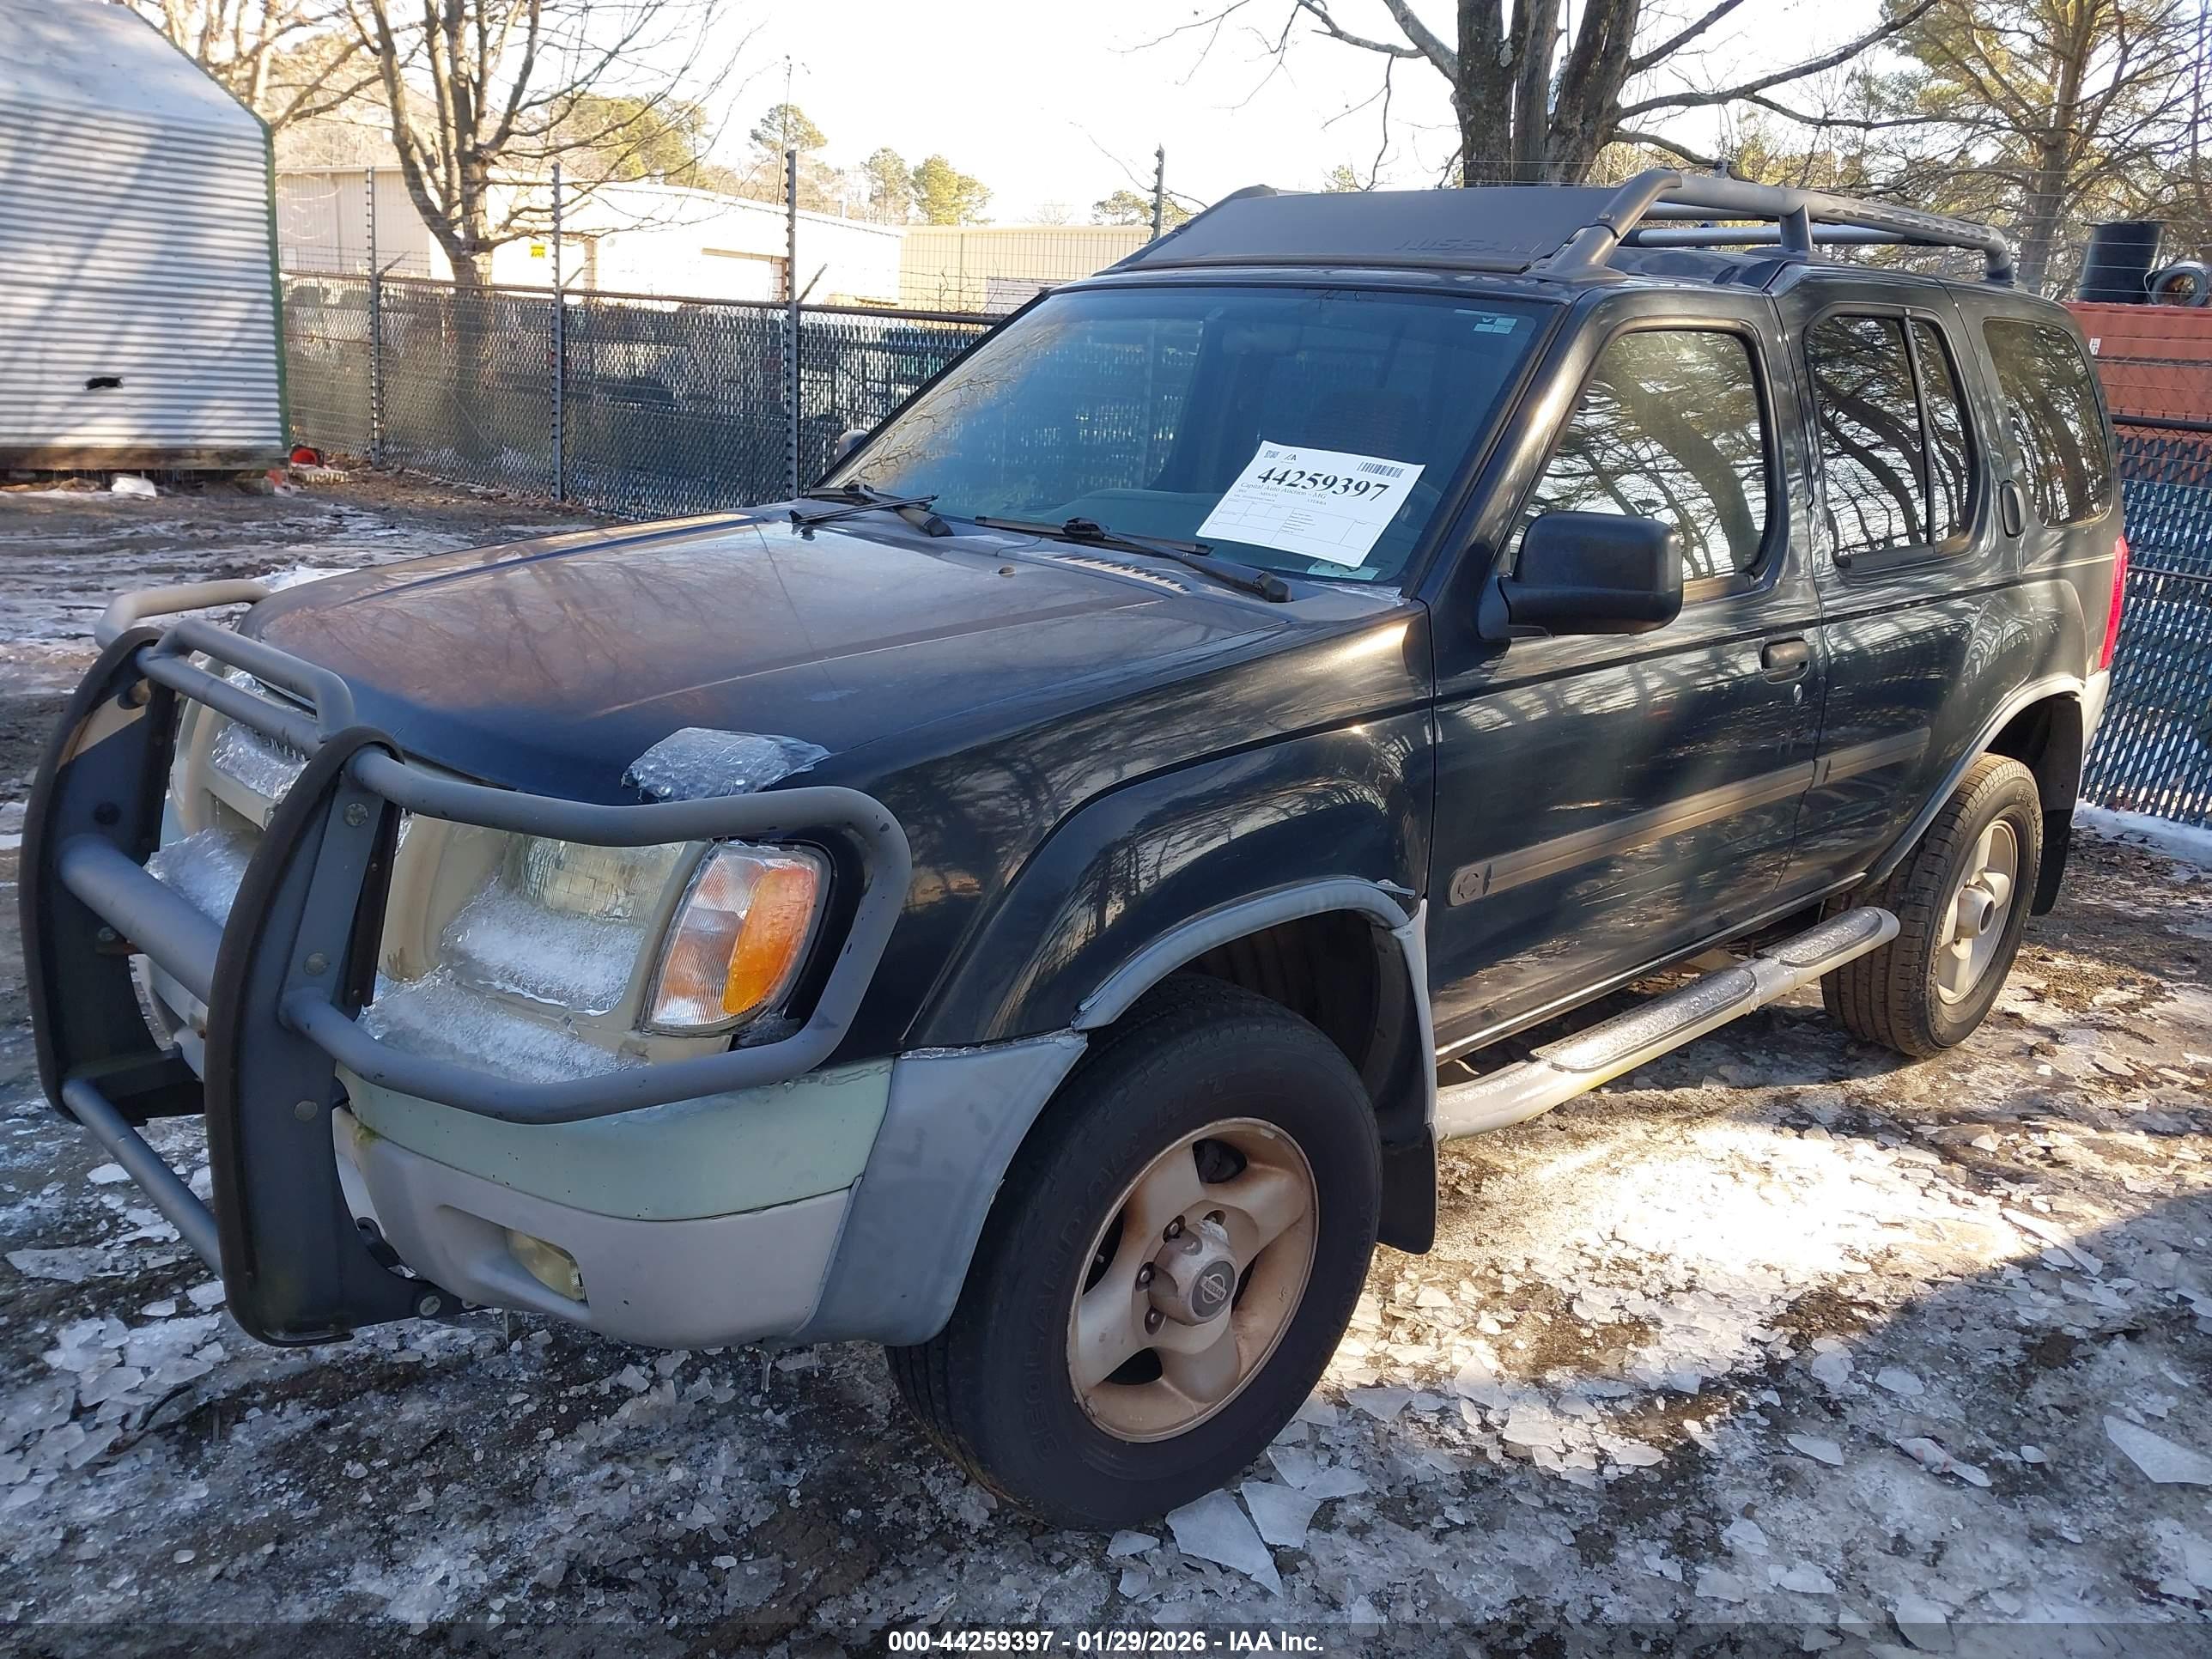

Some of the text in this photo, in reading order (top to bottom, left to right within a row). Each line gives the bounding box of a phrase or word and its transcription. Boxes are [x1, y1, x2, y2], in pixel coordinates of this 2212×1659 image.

[1240, 482, 1264, 490] Capital
[1264, 483, 1280, 492] Auto
[1279, 487, 1307, 496] Auction
[1311, 491, 1328, 500] MG
[1257, 466, 1390, 501] 44259397
[1203, 1279, 1225, 1299] NISSAN
